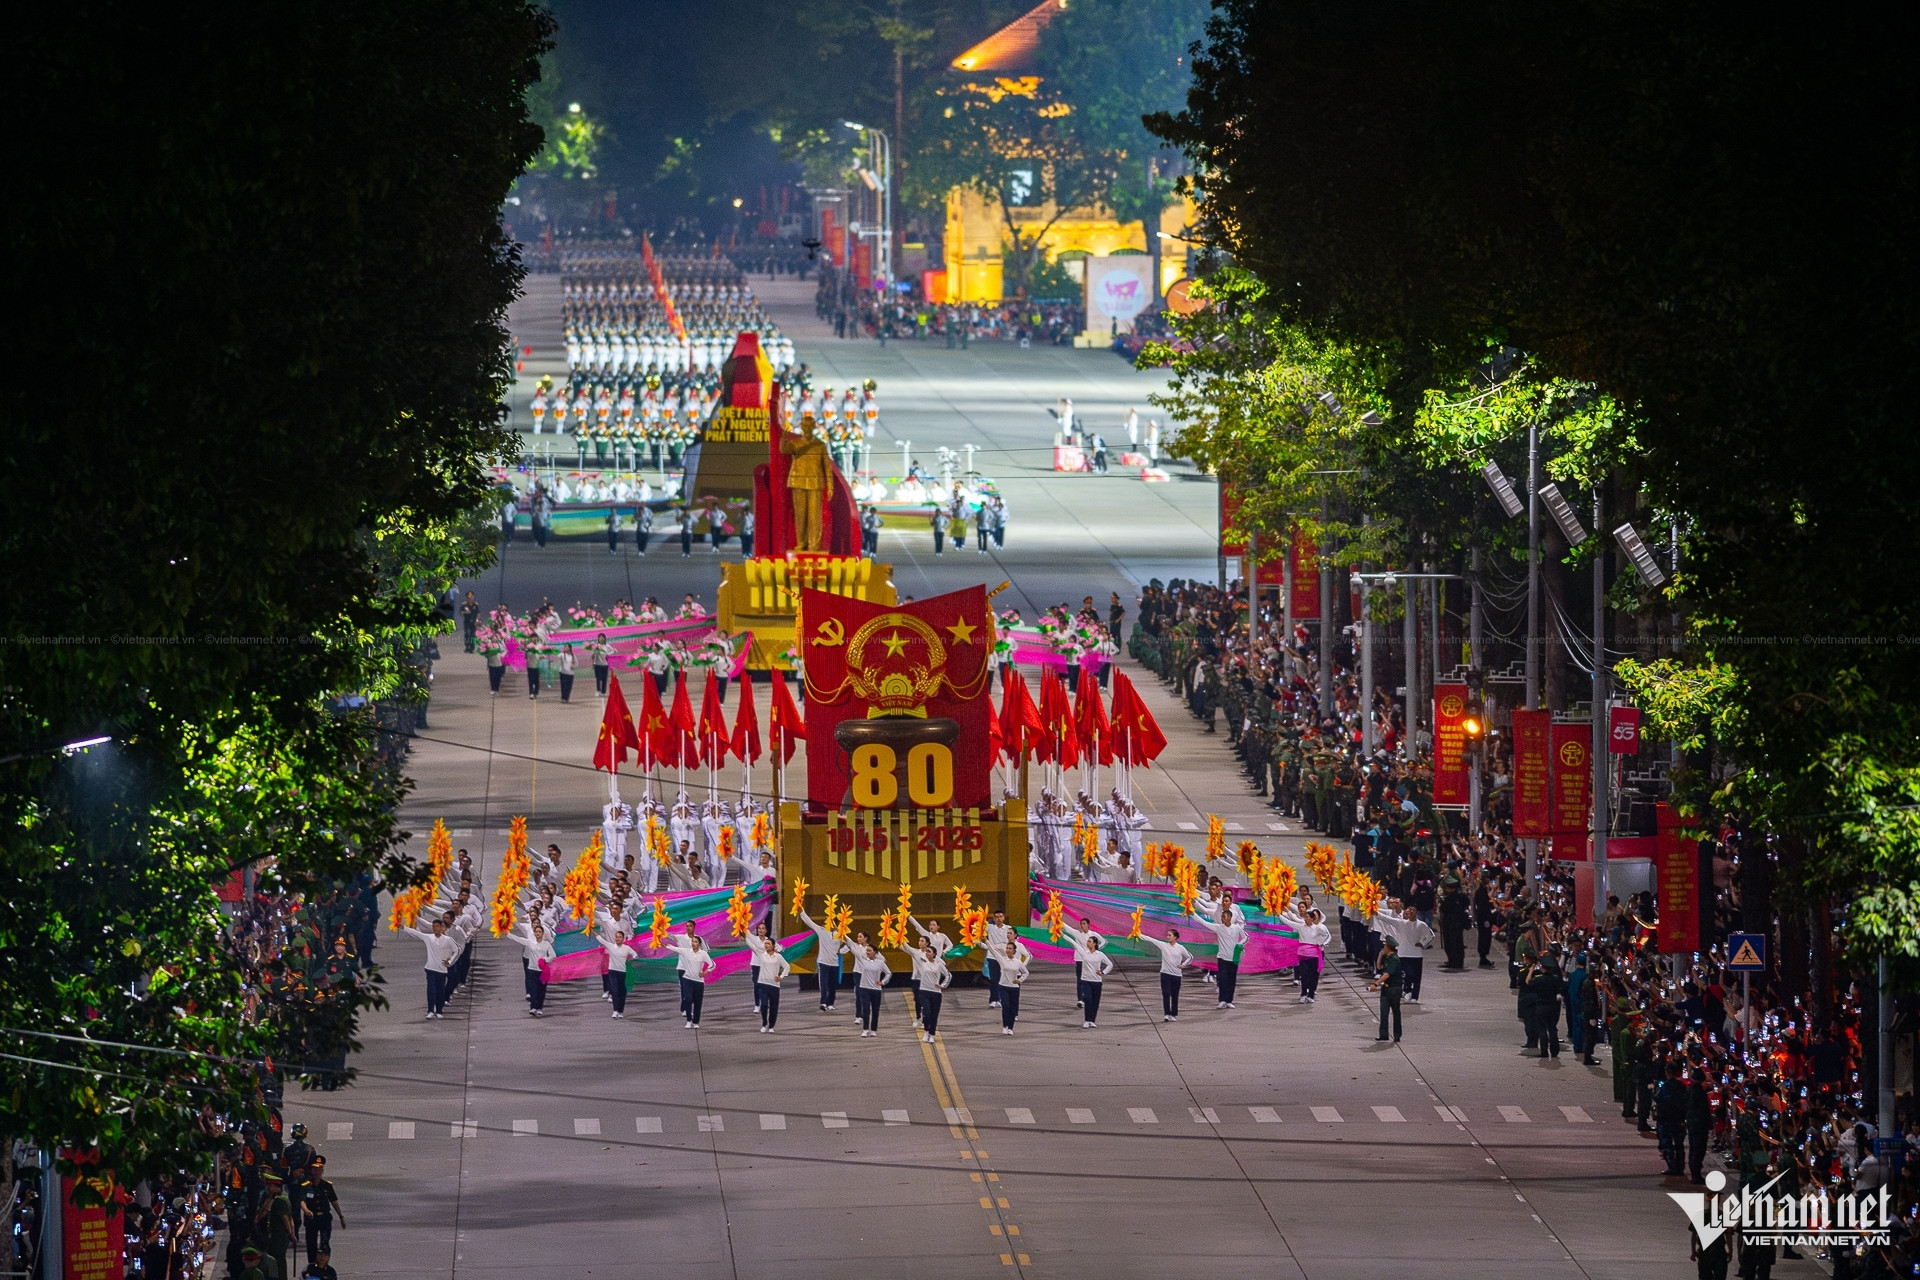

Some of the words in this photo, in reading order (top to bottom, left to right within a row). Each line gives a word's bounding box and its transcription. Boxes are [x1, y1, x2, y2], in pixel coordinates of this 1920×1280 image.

[1613, 725, 1635, 740] 5G
[851, 742, 954, 808] 80
[826, 826, 888, 853] 1945
[917, 825, 984, 851] 2025
